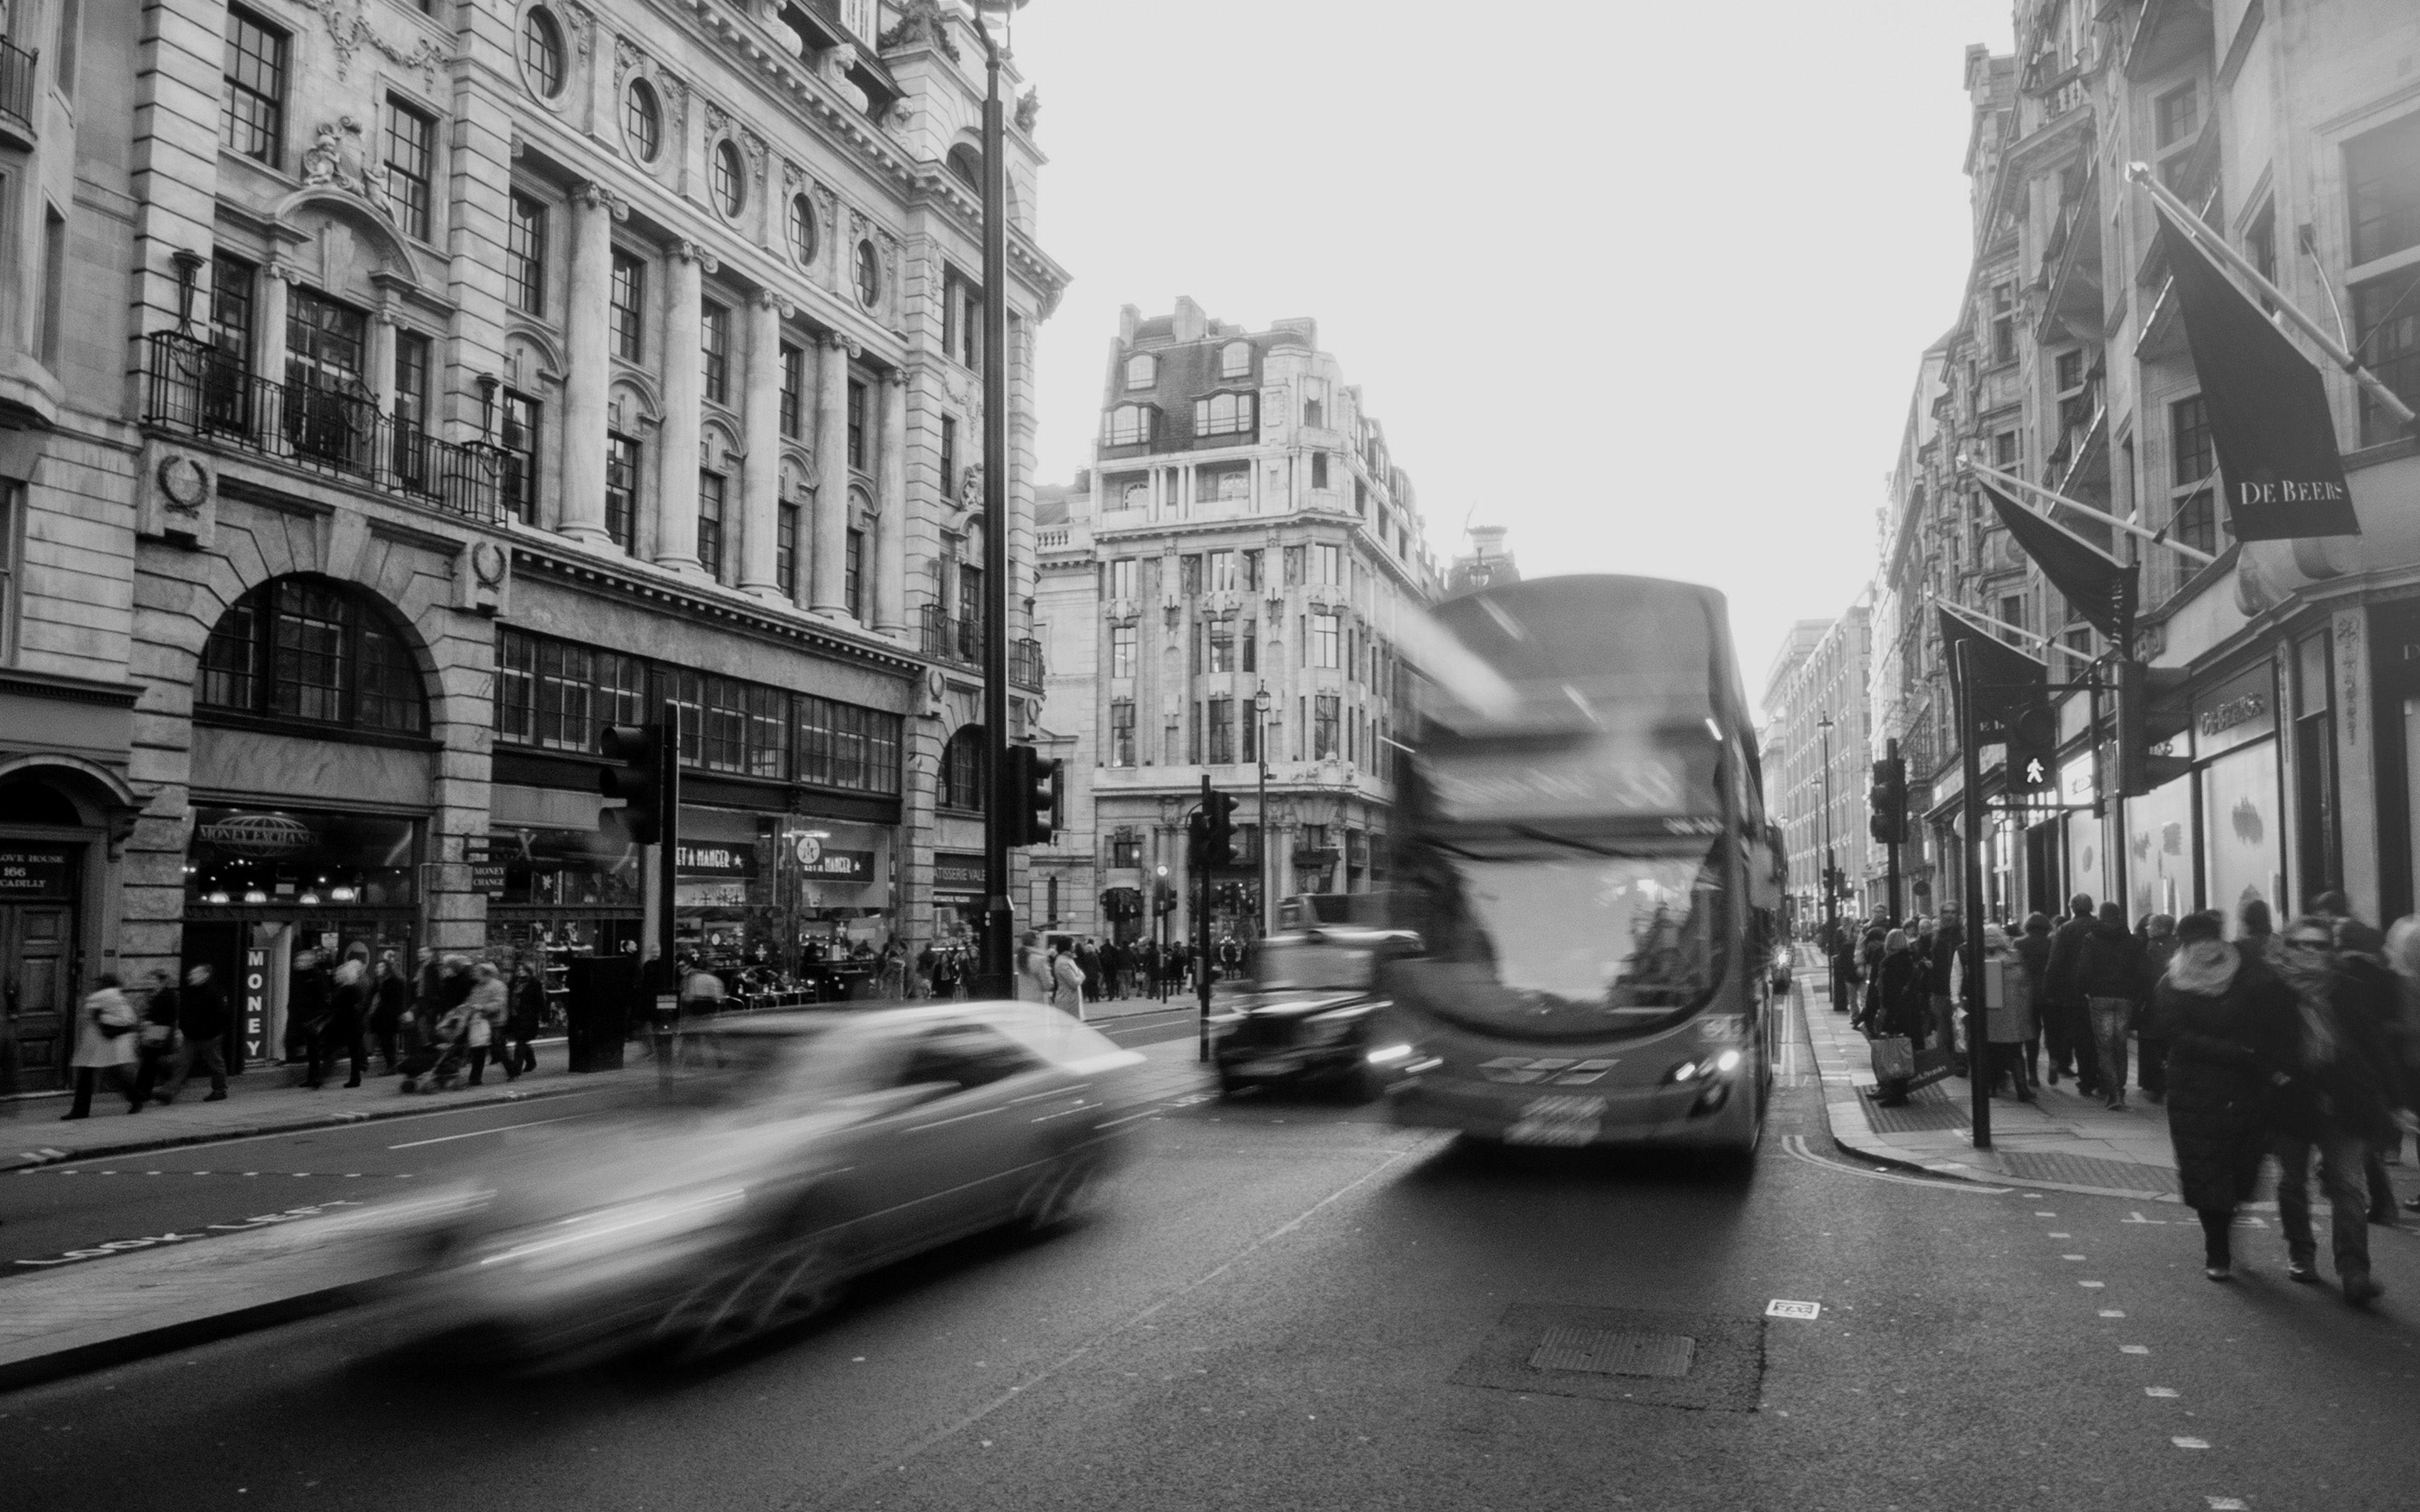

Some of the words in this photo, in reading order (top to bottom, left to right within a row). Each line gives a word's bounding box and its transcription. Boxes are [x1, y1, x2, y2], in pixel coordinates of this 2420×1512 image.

[2238, 481, 2276, 505] DE
[2281, 480, 2342, 502] BEERS
[0, 854, 25, 862] OVE
[676, 847, 687, 866] ET
[696, 849, 730, 868] MANGER
[474, 867, 505, 875] MONEY
[934, 867, 967, 881] ATISSERIE
[967, 869, 985, 882] VALE
[0, 879, 47, 888] CADILLY
[246, 951, 263, 1057] MONEY
